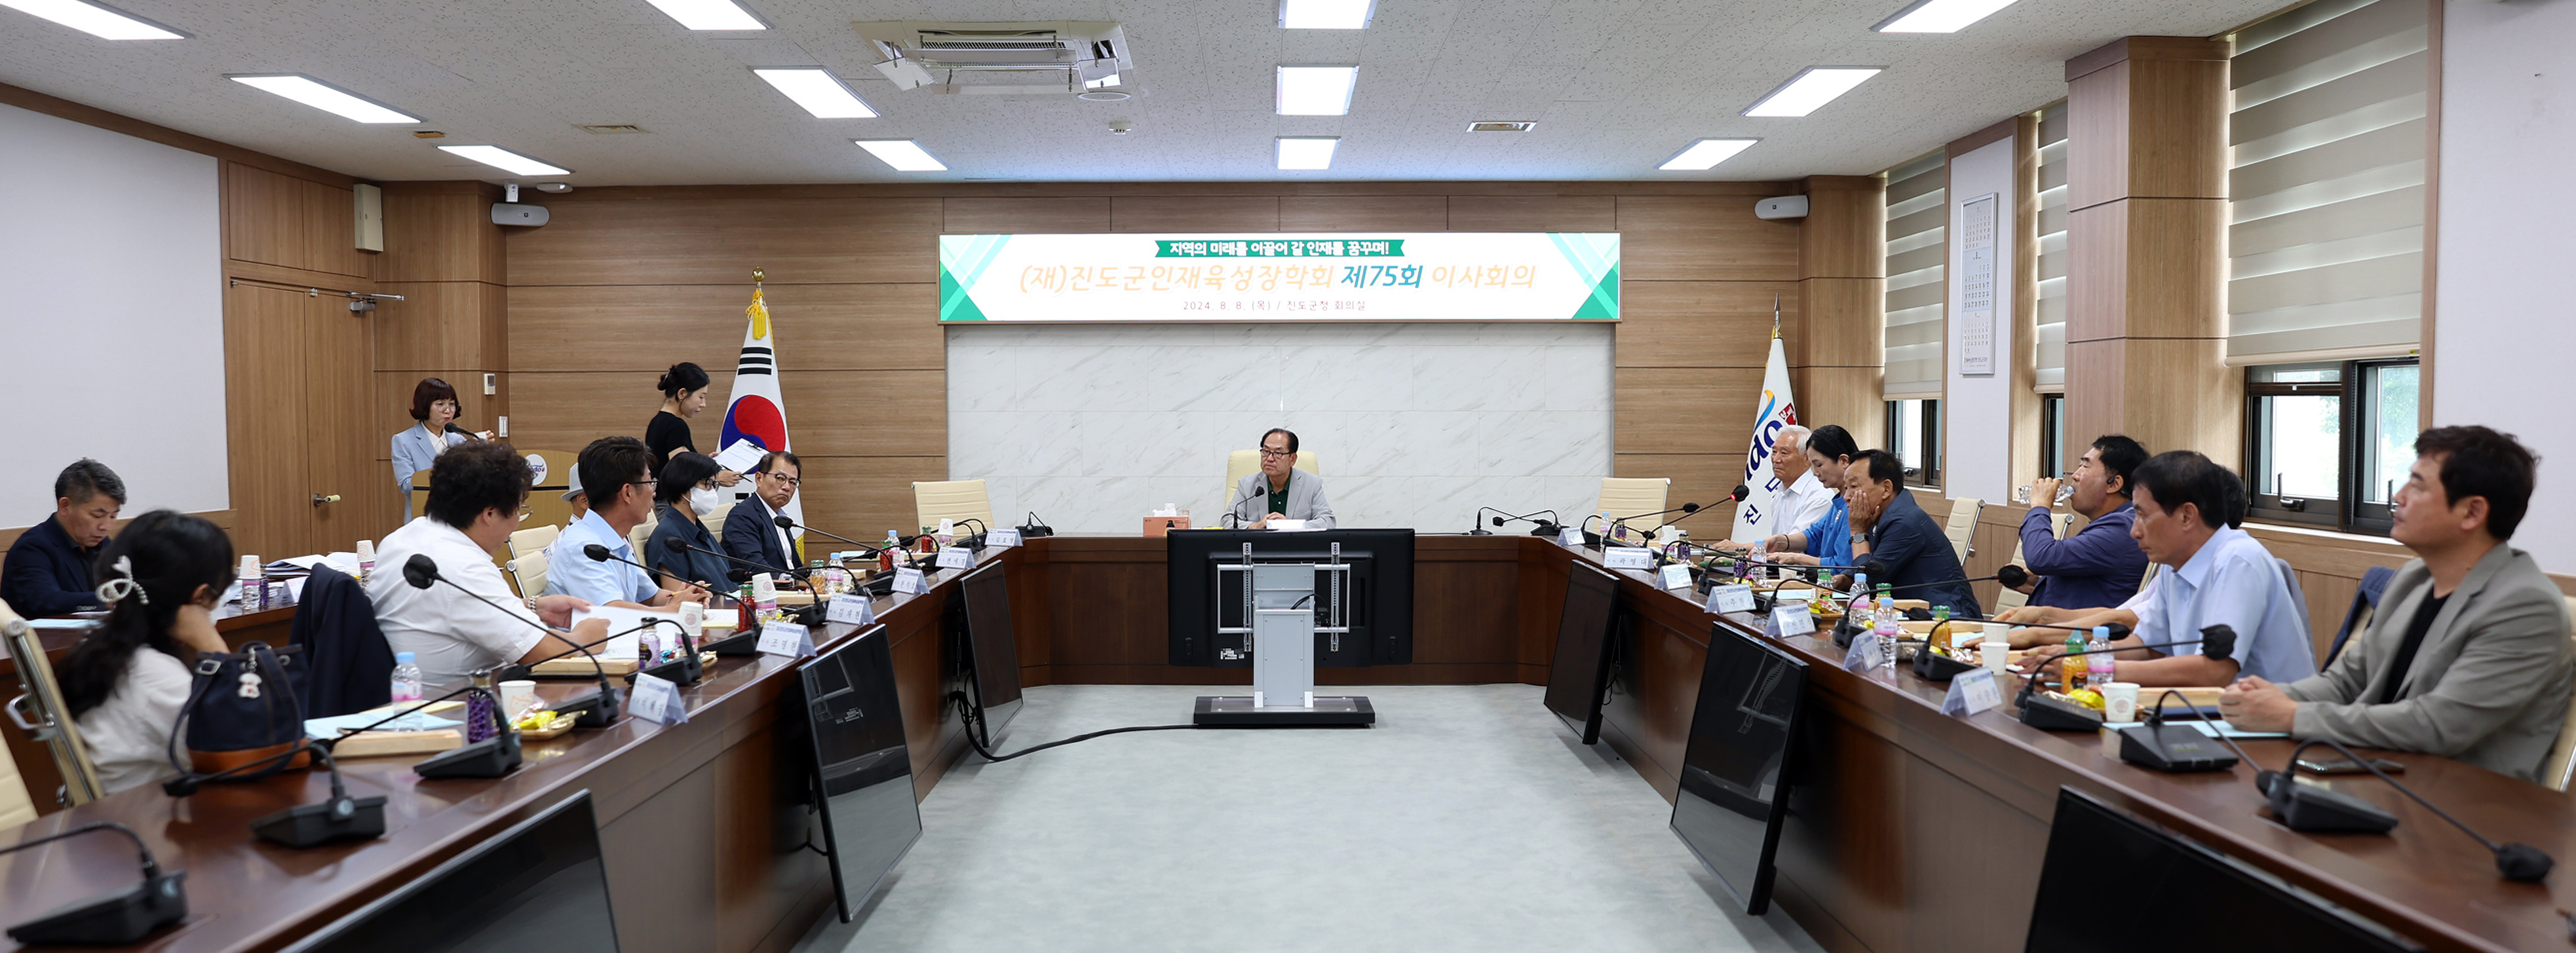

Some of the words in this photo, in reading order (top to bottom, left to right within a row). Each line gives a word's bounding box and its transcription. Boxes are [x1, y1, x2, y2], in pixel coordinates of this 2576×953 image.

[1170, 242, 1206, 256] 지역의
[1210, 242, 1248, 257] 미래를
[1251, 242, 1288, 256] 이끌어
[1291, 242, 1304, 256] 갈
[1307, 242, 1345, 257] 인재를
[1347, 242, 1389, 256] 꿈꾸며!
[1020, 264, 1334, 293] (재)진도군인재육성장학회
[1341, 264, 1423, 288] 제75회
[1432, 265, 1536, 288] 이사회의
[1183, 301, 1214, 310] 2024.
[1220, 301, 1229, 310] 8.
[1236, 301, 1245, 310] 8.
[1252, 301, 1271, 311] (목)
[1287, 301, 1328, 311] 진도군청
[1335, 301, 1365, 311] 회의실
